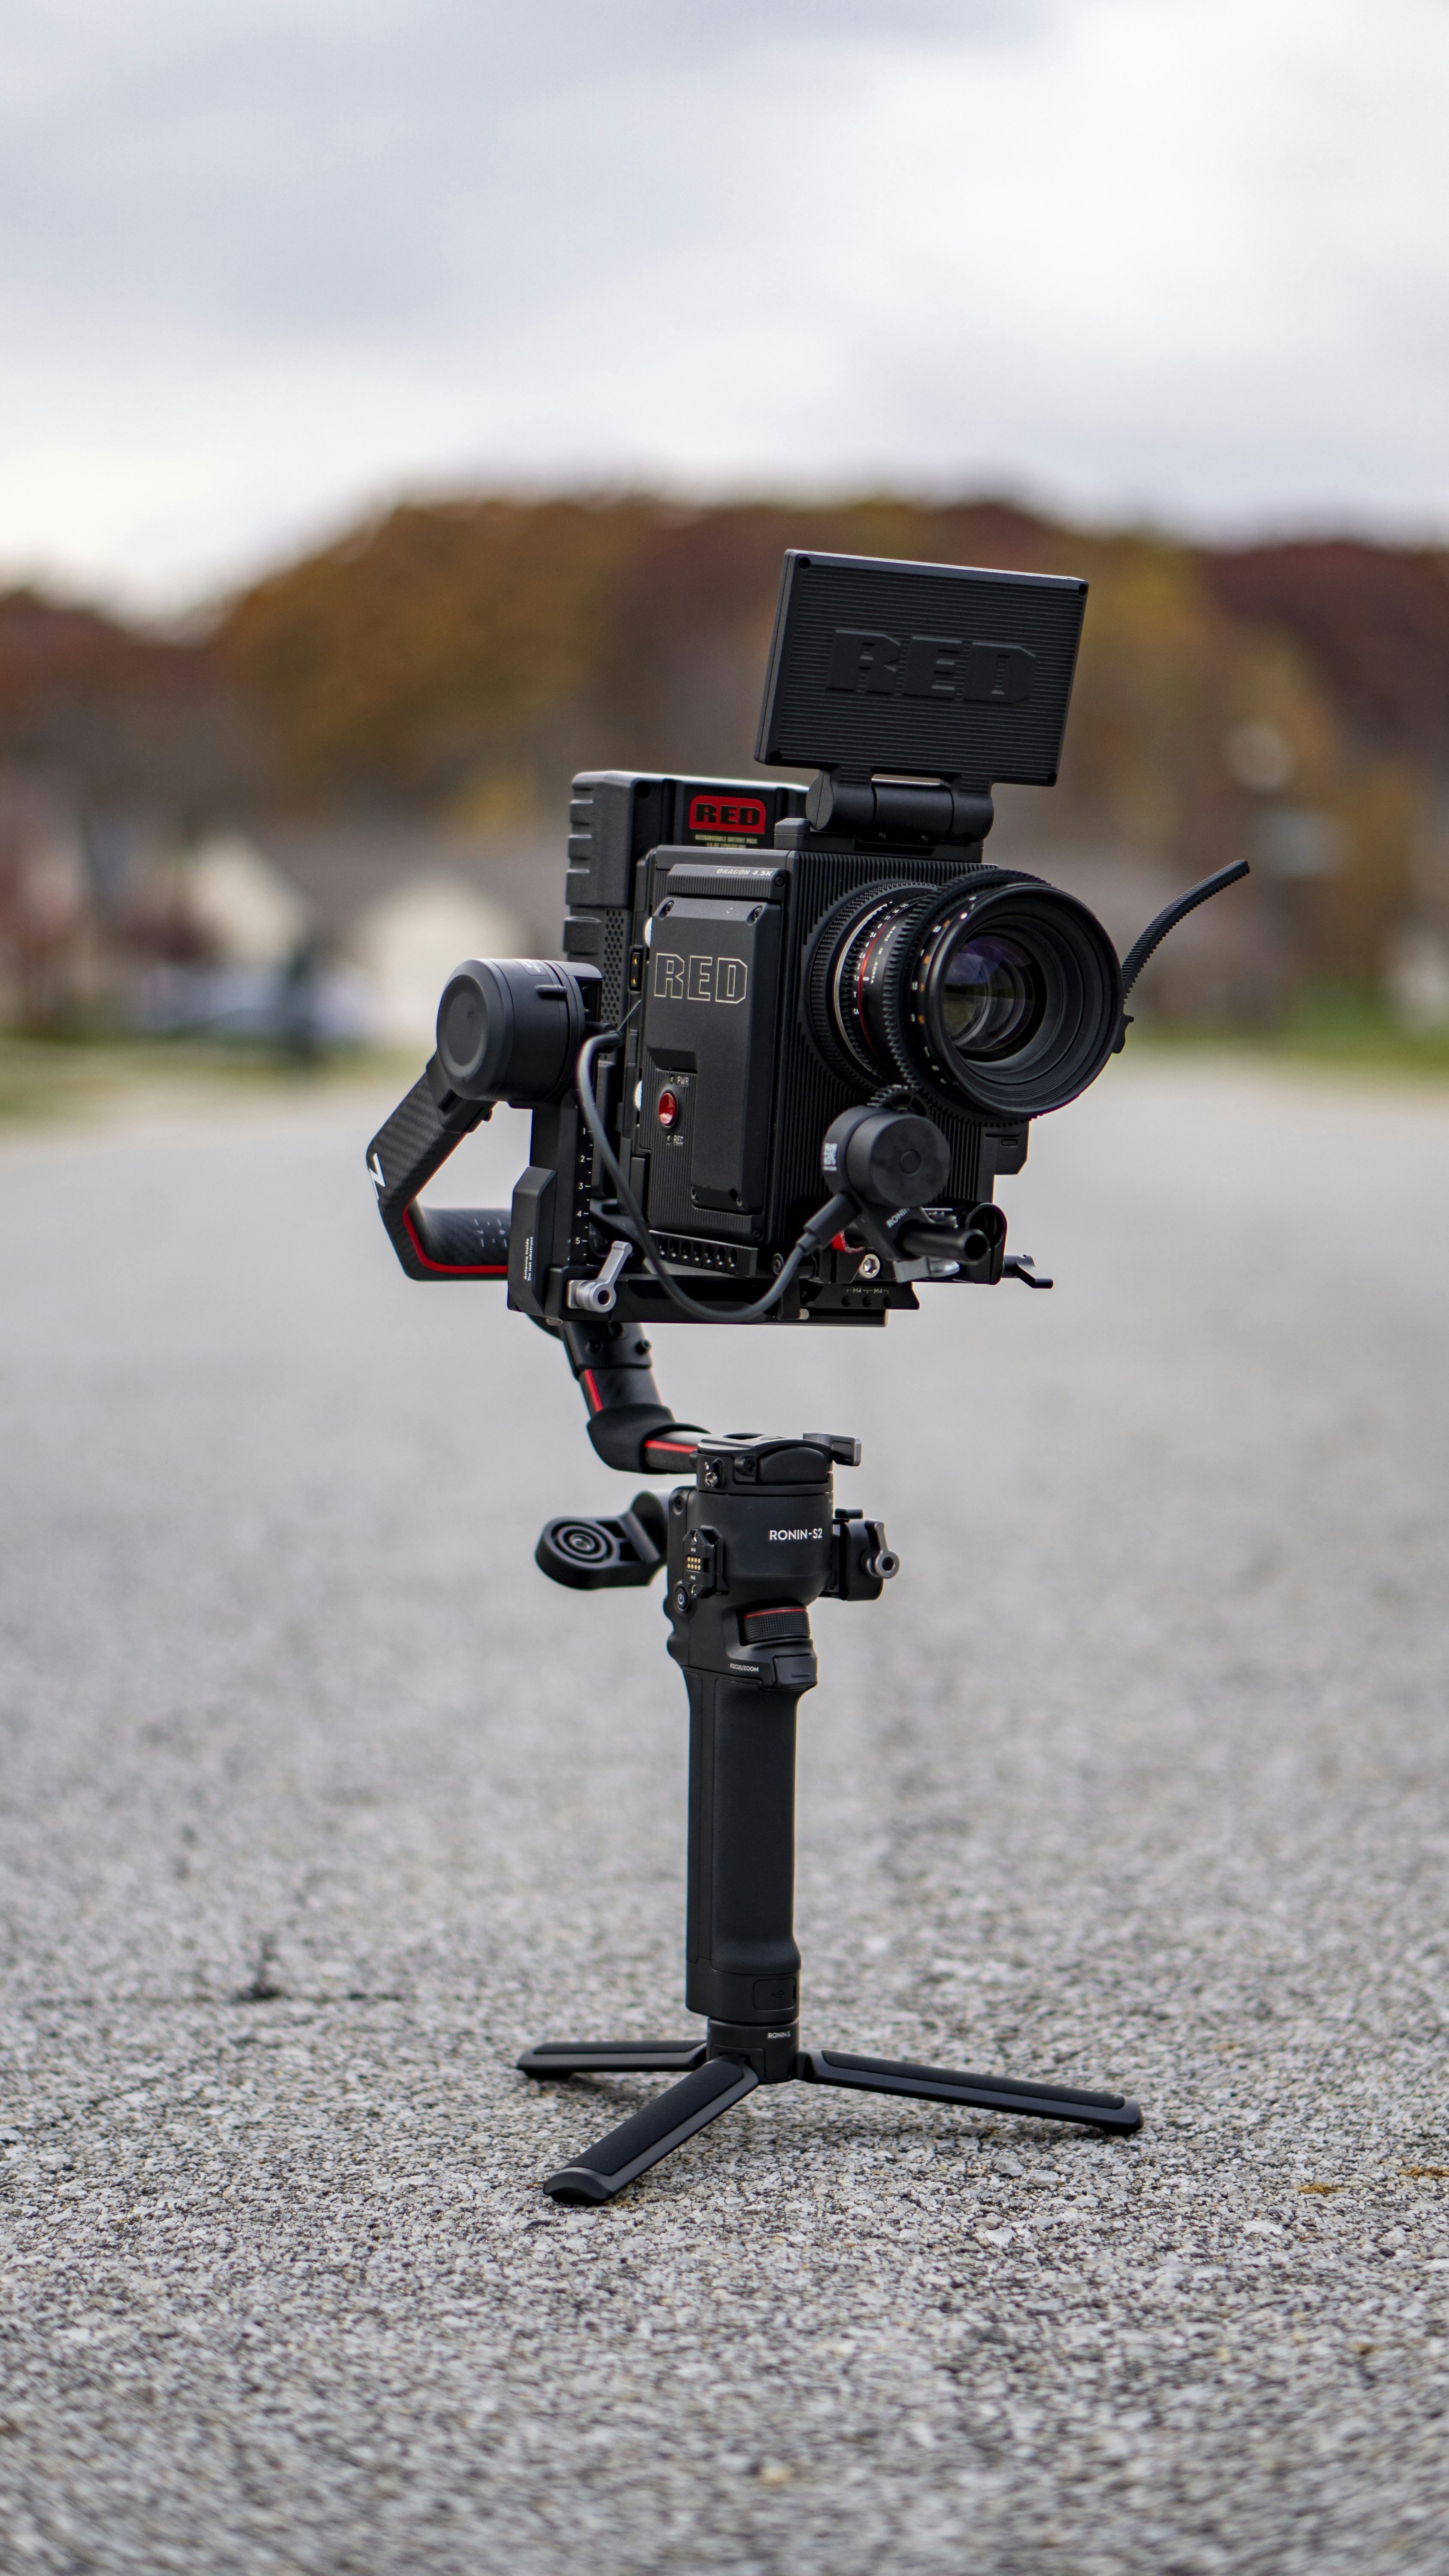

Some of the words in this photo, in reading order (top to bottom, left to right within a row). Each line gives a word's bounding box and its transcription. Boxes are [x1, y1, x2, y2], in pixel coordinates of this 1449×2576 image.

[827, 629, 1037, 704] RED
[695, 802, 761, 826] RED
[884, 926, 897, 942] MADE
[654, 953, 748, 1004] RED
[870, 962, 879, 984] KOREA
[677, 1076, 689, 1086] PWR
[673, 1135, 684, 1145] REC
[527, 1272, 531, 1281] Do
[770, 1528, 823, 1540] RONIN-S2
[730, 1663, 759, 1672] FOCUS/ZOOM
